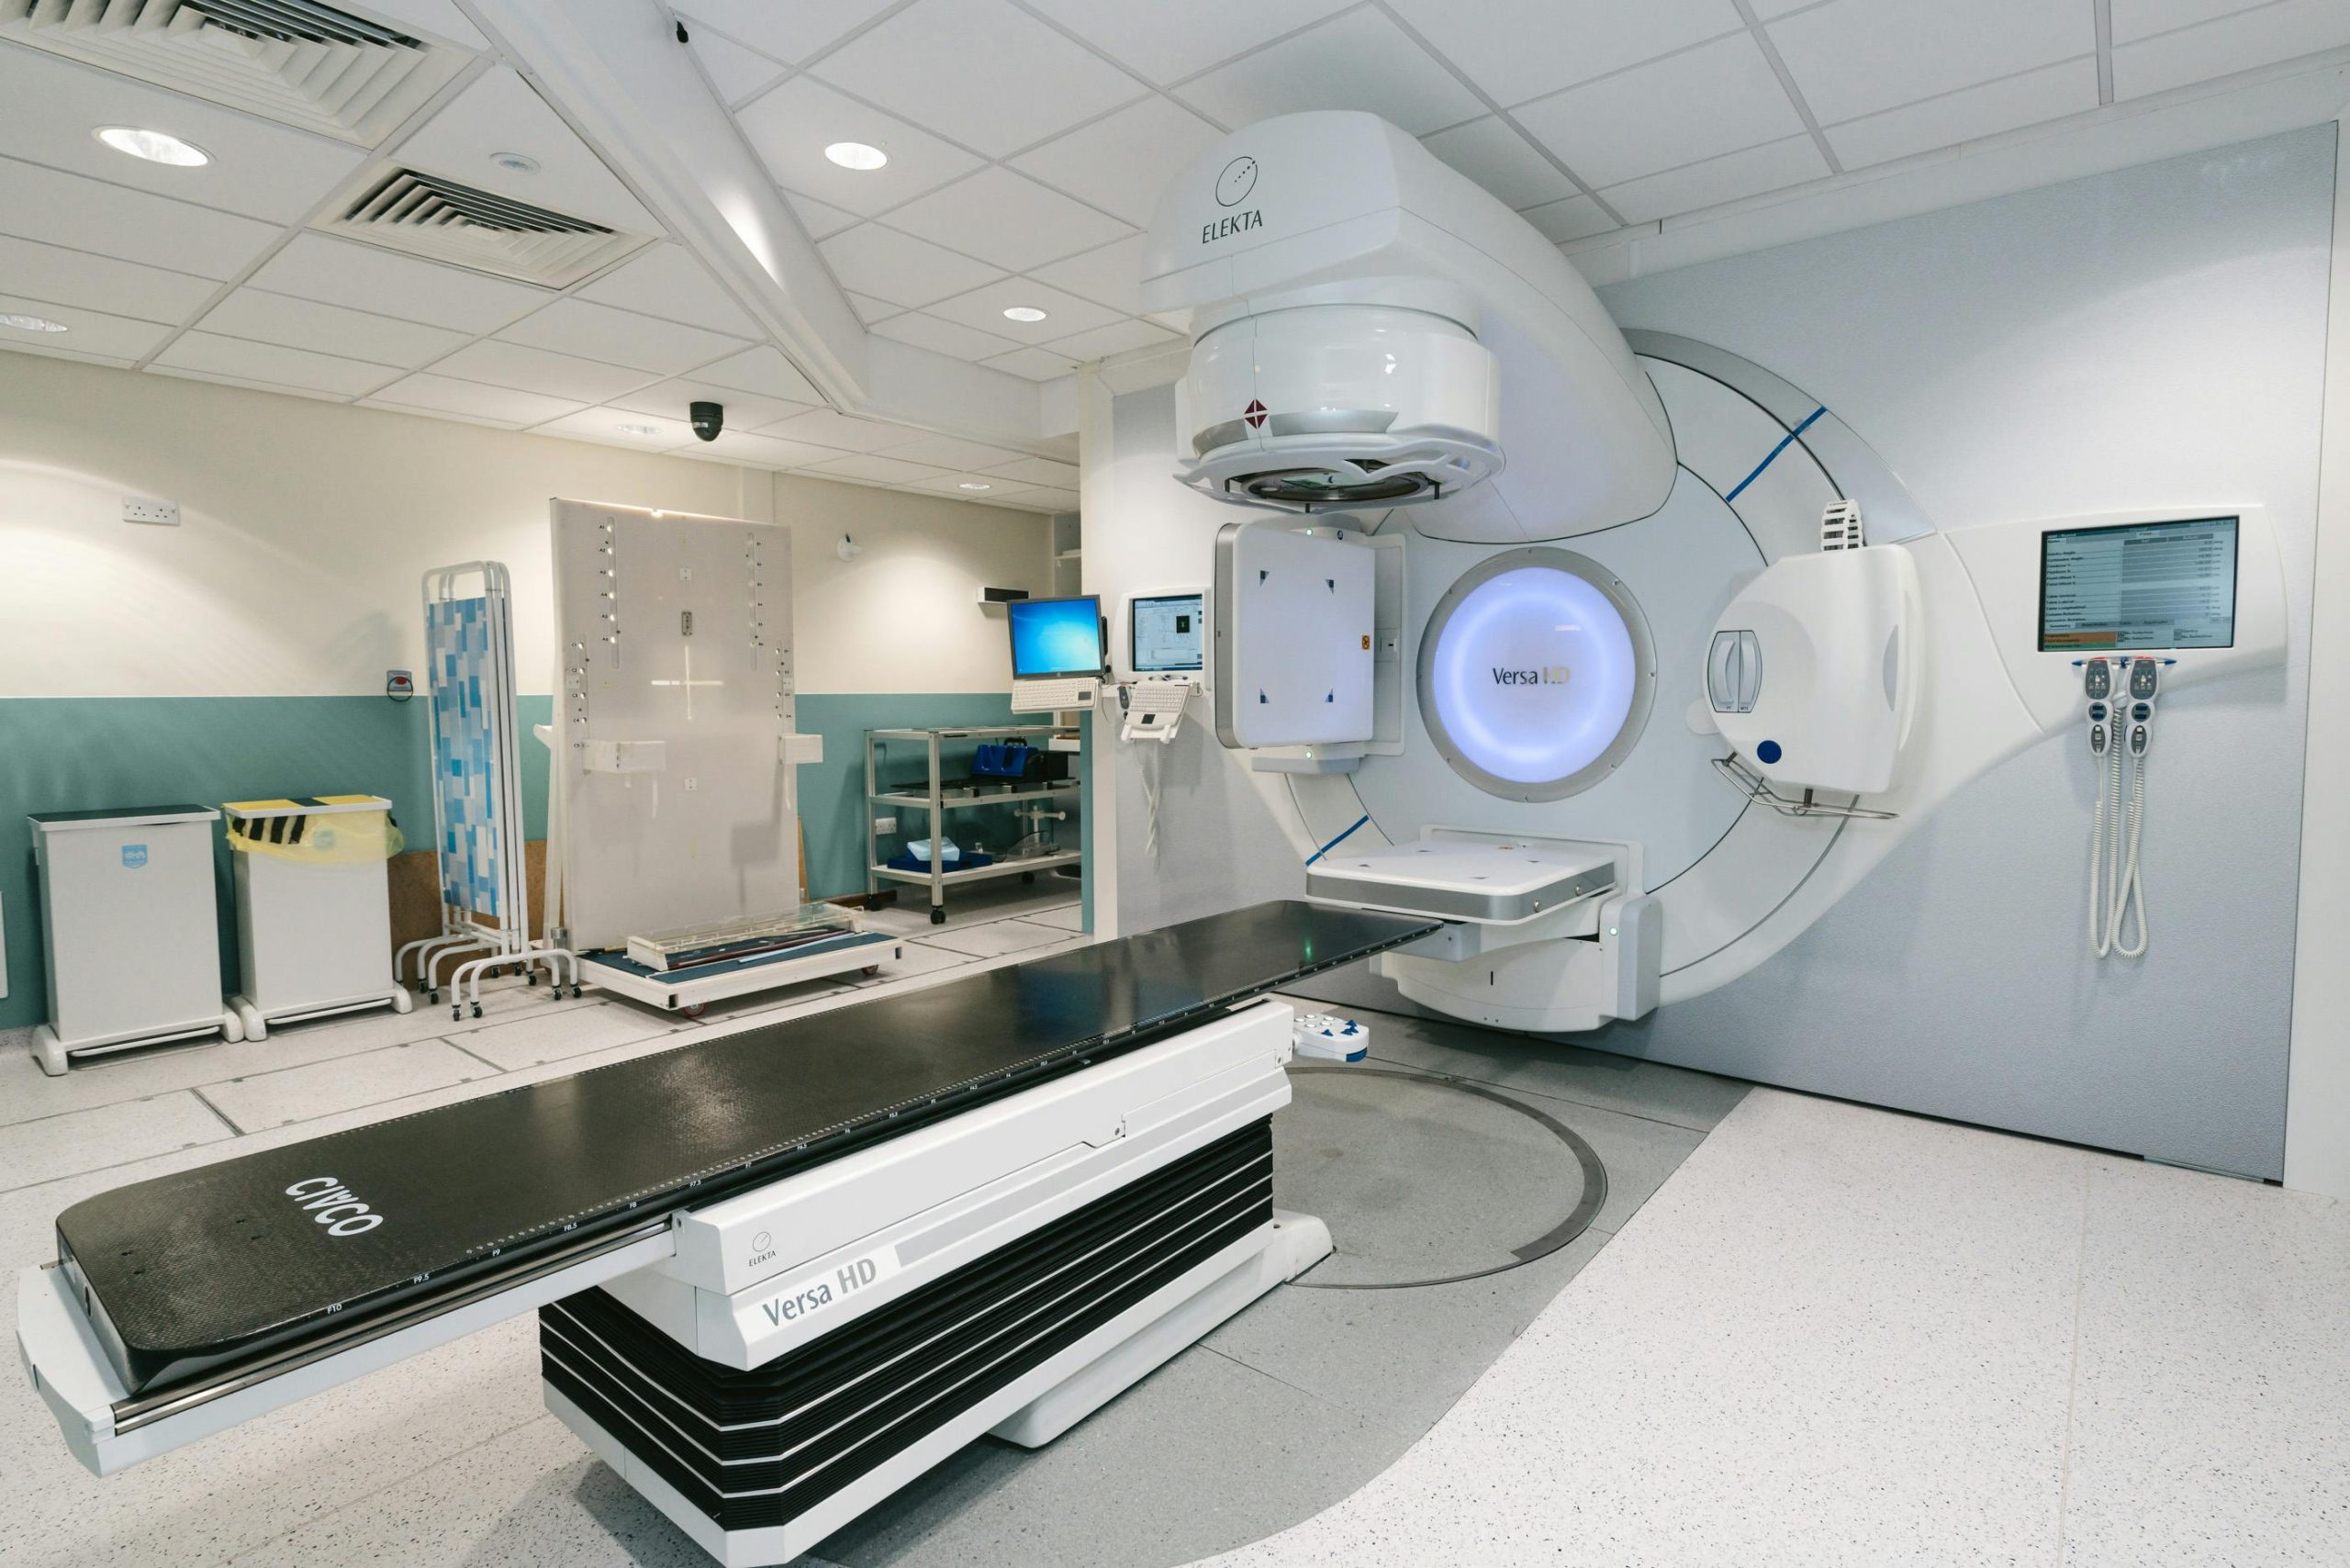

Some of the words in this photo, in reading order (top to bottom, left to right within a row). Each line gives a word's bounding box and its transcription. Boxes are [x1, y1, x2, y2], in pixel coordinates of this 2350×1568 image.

[1202, 209, 1263, 244] ELEKTA
[1492, 667, 1539, 685] Versa
[689, 1179, 701, 1188] F7.5
[285, 1177, 384, 1237] CIVCO
[629, 1201, 637, 1209] F8
[564, 1222, 577, 1232] F8.5
[492, 1249, 500, 1257] F9
[748, 1249, 777, 1267] ELEKTA
[413, 1272, 430, 1284] F9.5
[762, 1283, 833, 1327] Versa
[836, 1259, 877, 1294] HD
[327, 1304, 342, 1315] F10
